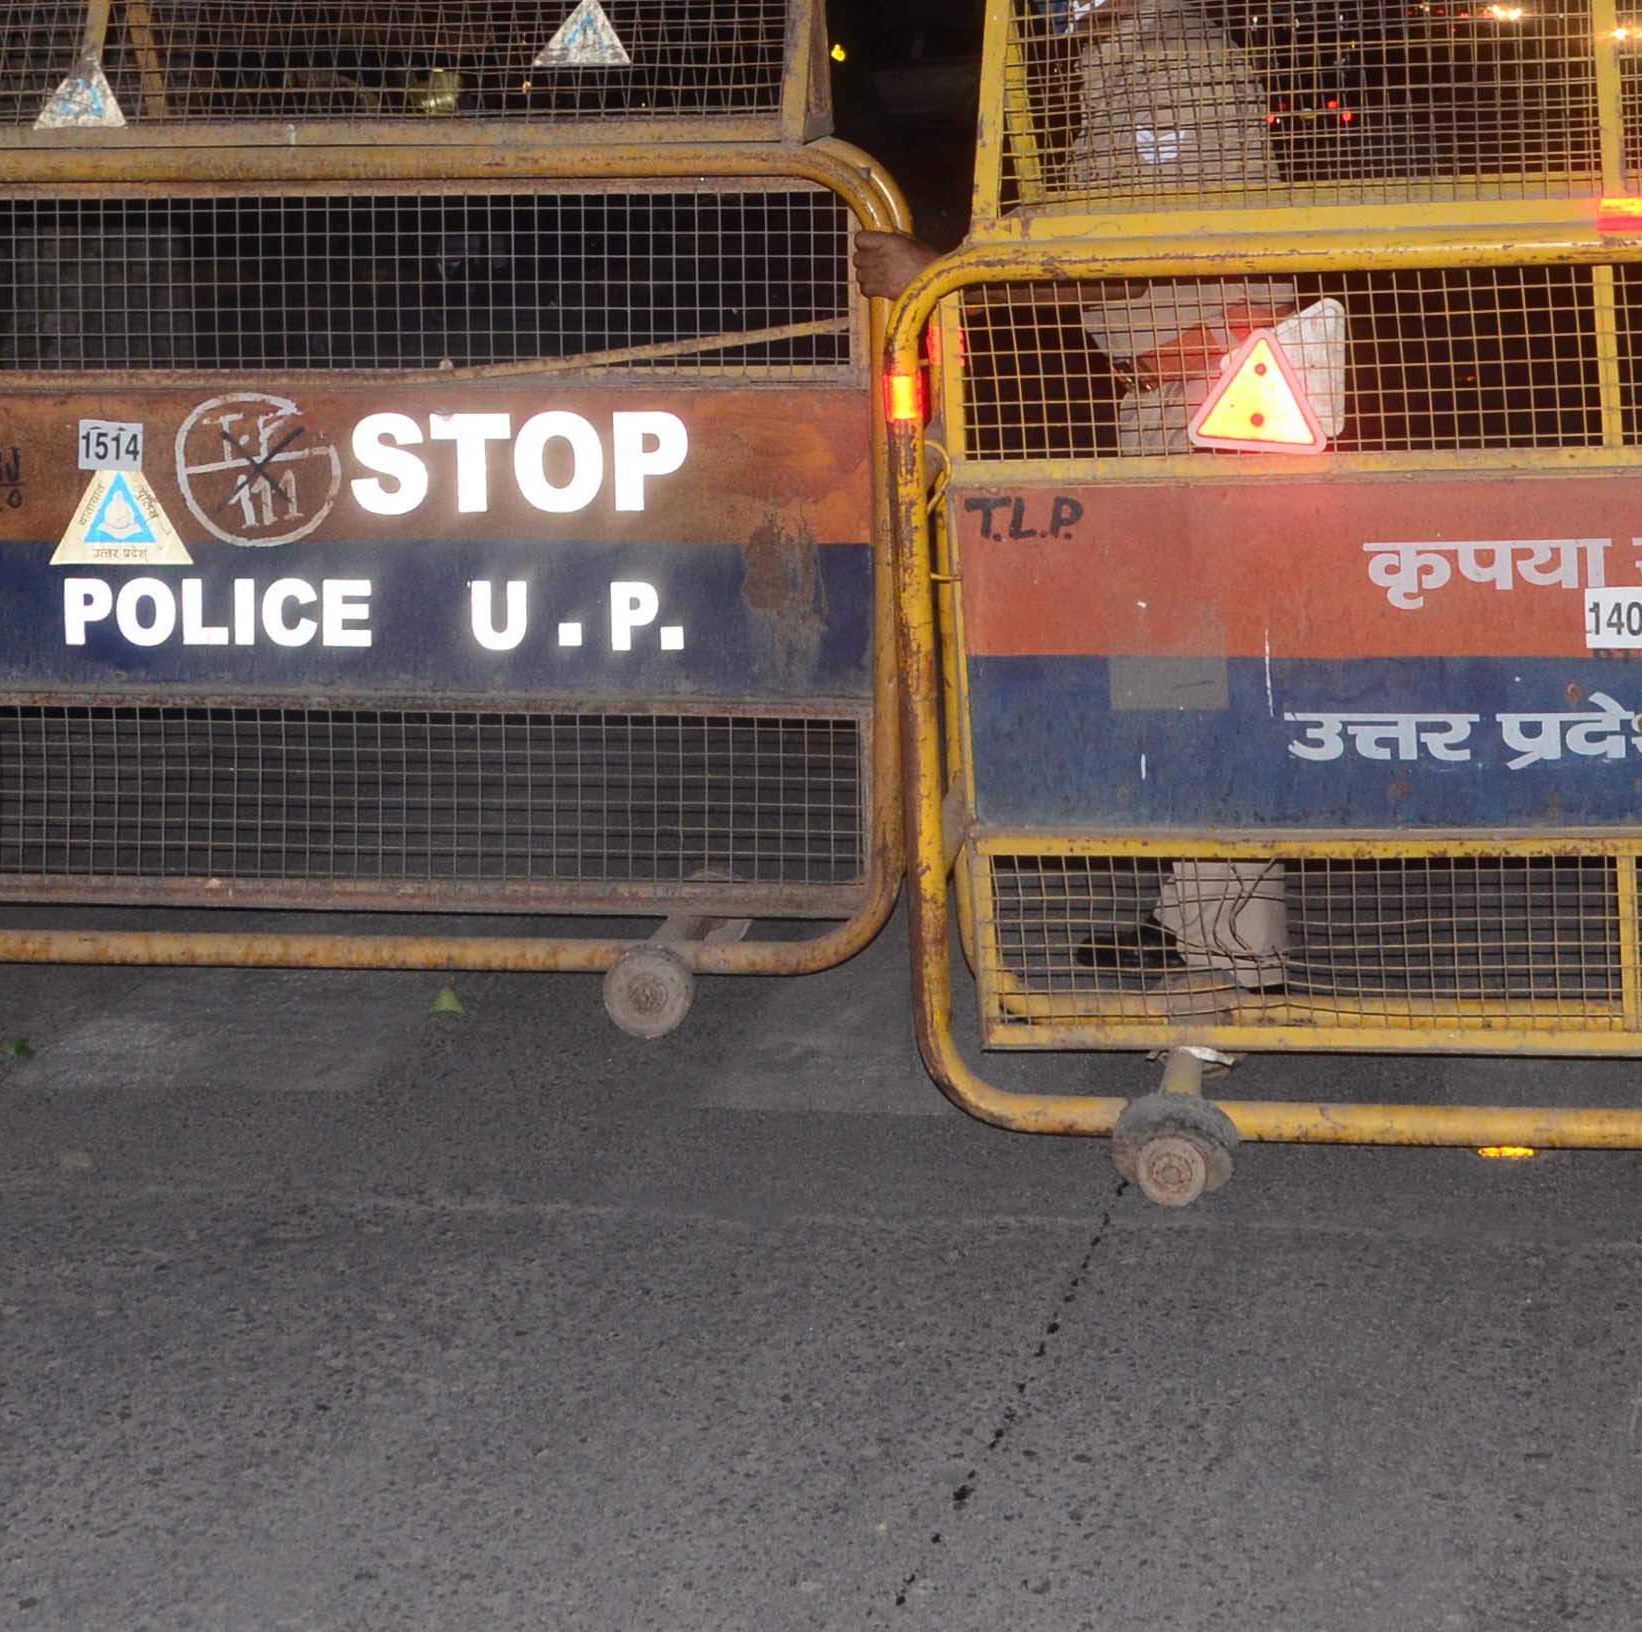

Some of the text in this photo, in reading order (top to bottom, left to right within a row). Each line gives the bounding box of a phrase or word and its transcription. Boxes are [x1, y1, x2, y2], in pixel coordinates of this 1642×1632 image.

[81, 431, 140, 462] 1514
[351, 409, 689, 516] STOP
[1362, 537, 1612, 610] कृपया
[62, 576, 372, 648] POLICE
[1283, 710, 1480, 763] उत्तर
